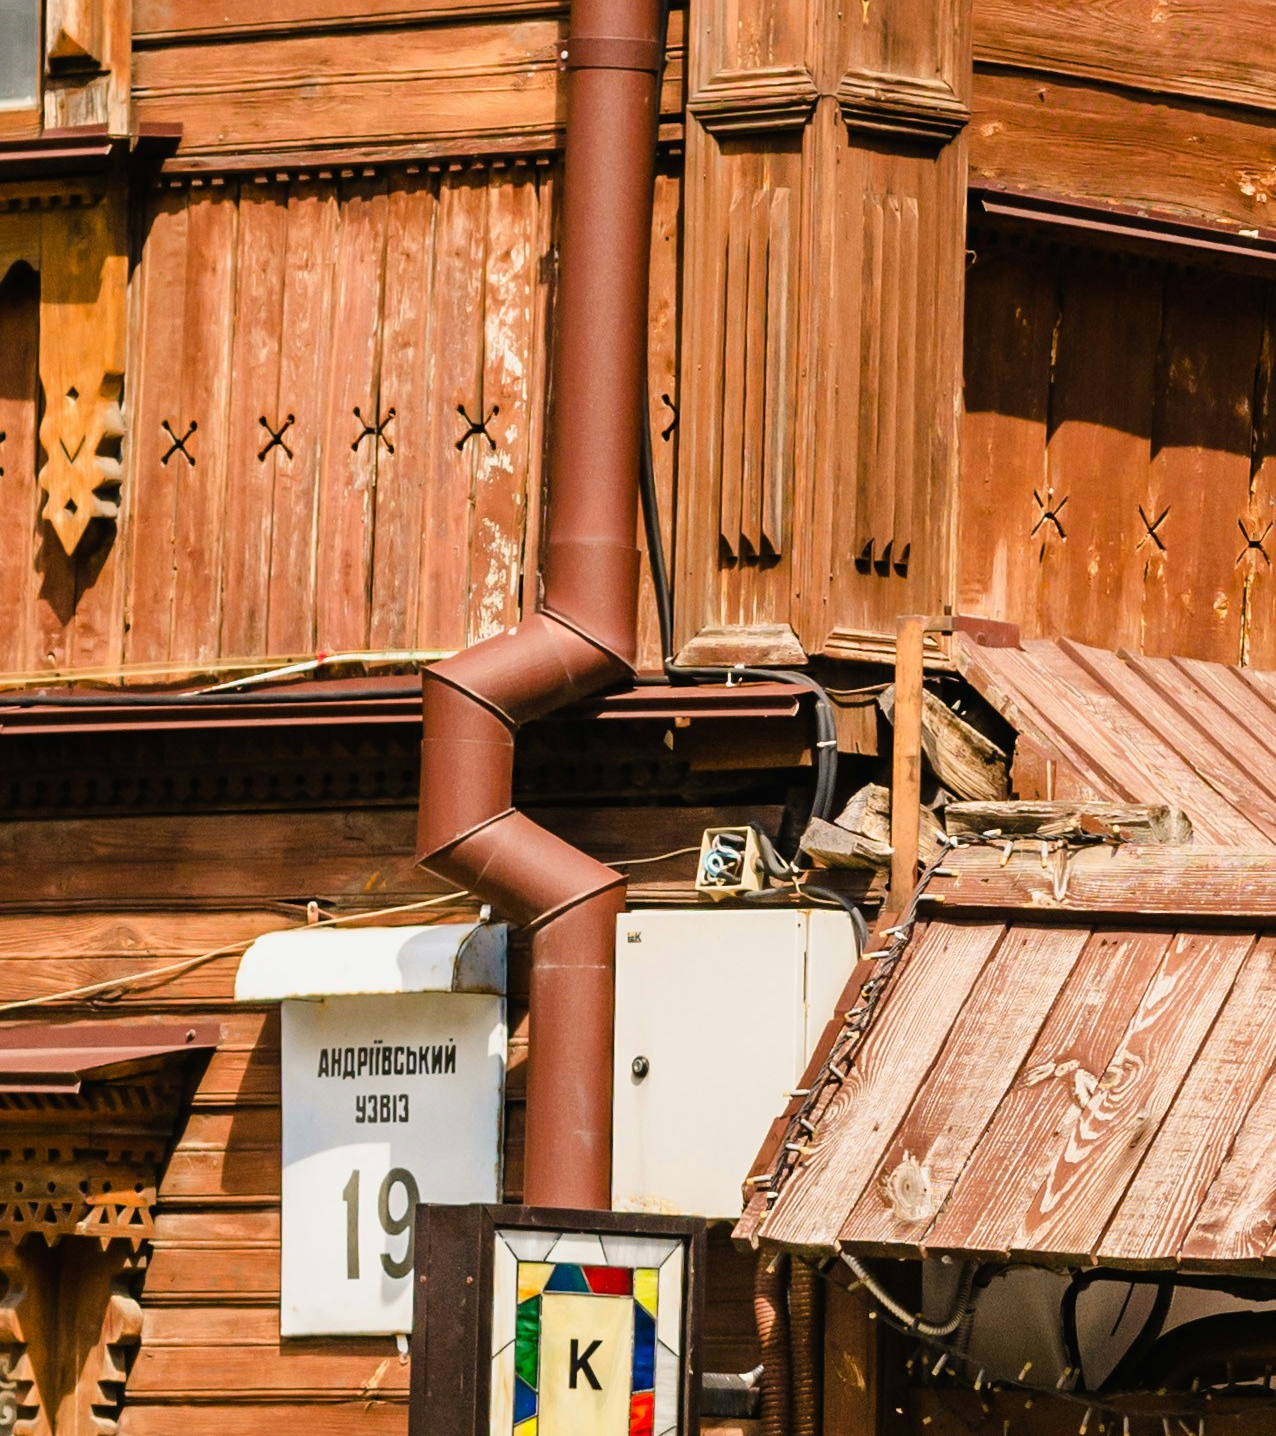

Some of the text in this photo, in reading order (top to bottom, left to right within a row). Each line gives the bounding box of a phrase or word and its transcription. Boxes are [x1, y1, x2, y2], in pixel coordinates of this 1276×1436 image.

[317, 1038, 457, 1079] АНДРІЇВСЬКИЙ
[355, 1093, 409, 1123] УЗВІЗ
[342, 1167, 421, 1279] 19
